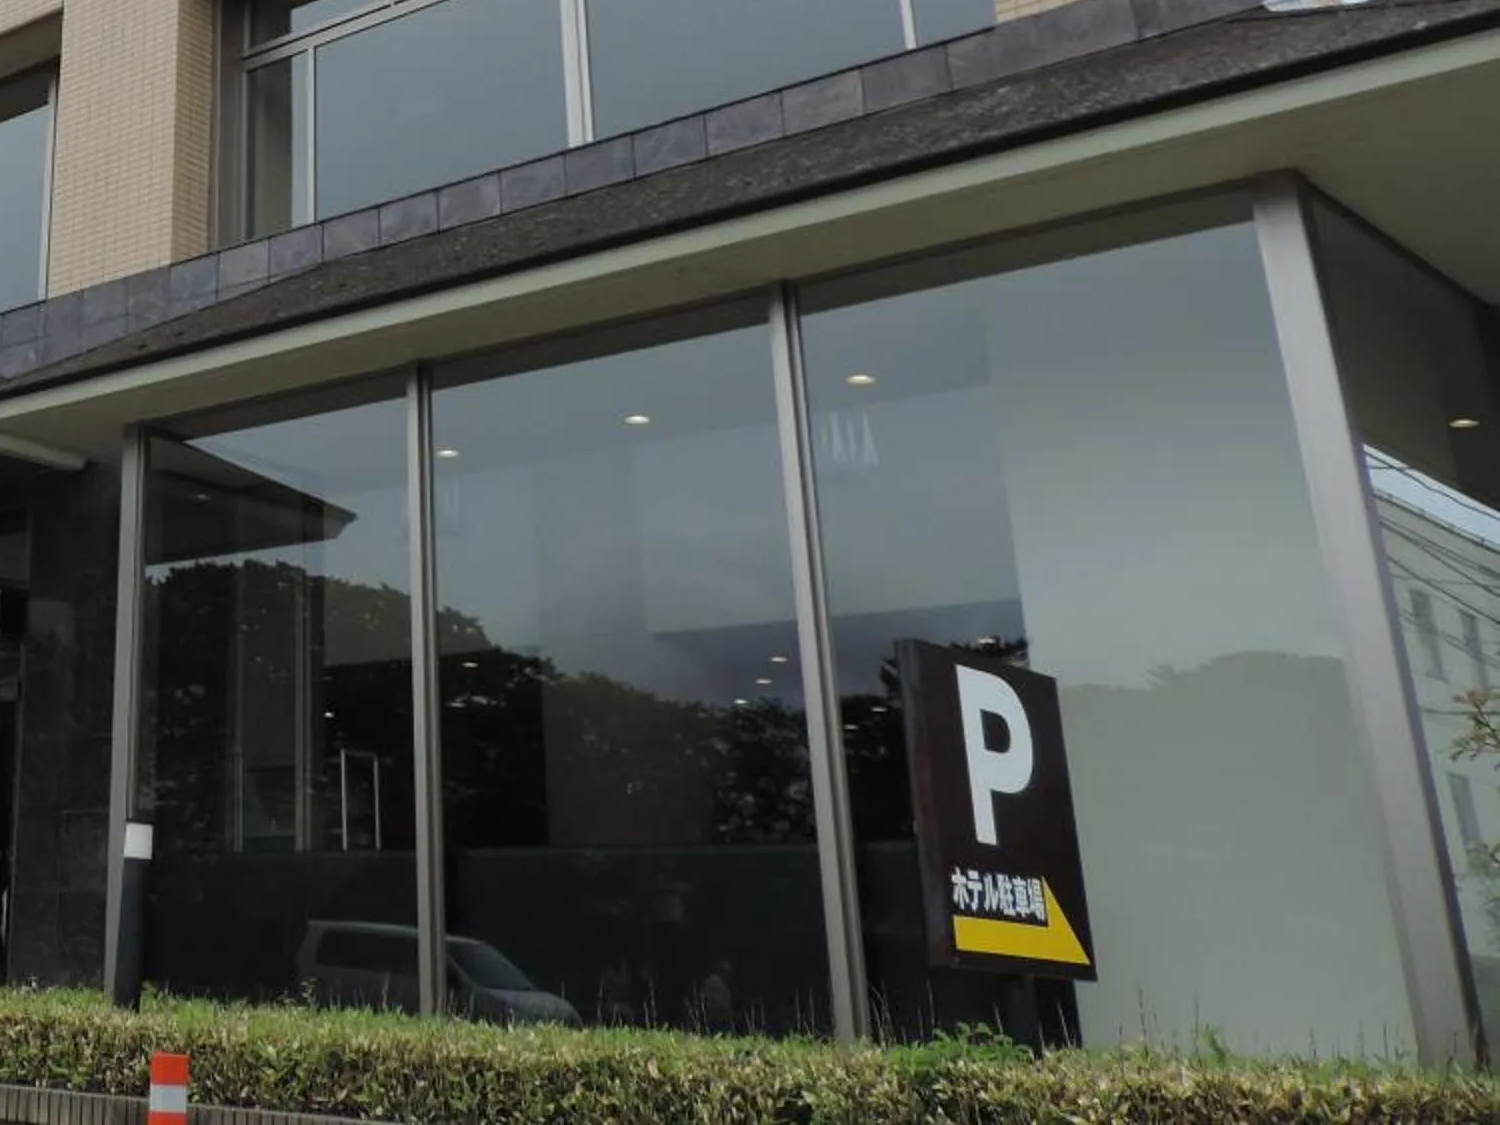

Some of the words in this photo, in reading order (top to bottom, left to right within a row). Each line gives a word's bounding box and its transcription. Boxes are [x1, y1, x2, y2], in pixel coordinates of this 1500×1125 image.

[955, 664, 1033, 845] P
[951, 866, 1045, 922] ホテル駐車場
